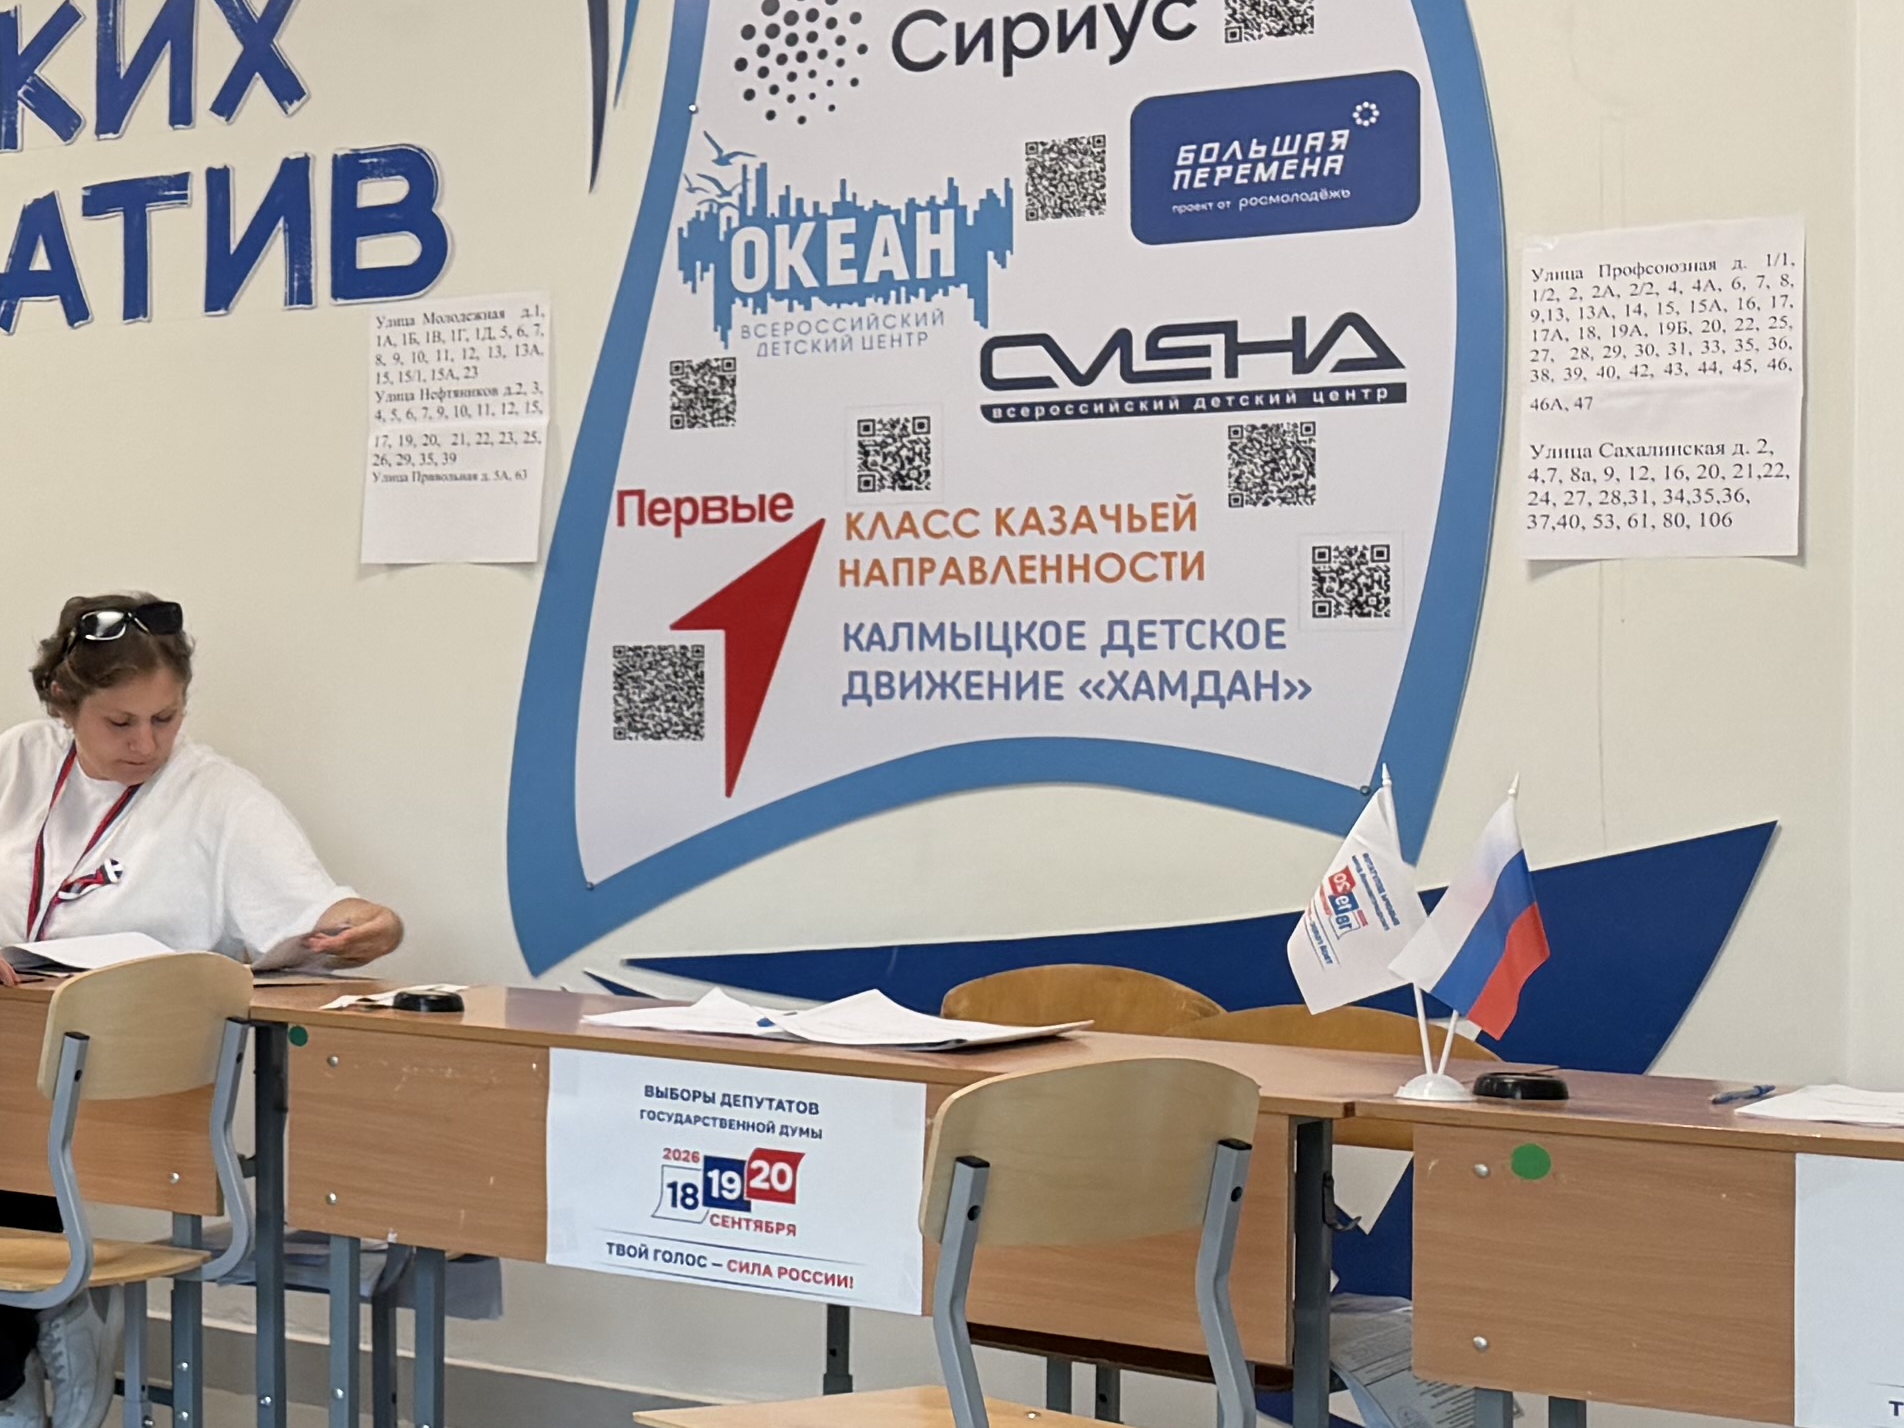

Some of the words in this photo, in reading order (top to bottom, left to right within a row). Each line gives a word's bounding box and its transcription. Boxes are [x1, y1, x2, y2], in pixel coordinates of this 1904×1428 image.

[1177, 129, 1350, 166] БОЛЬШАЯ
[1172, 155, 1345, 191] ПЕРЕМЕНА
[1170, 200, 1215, 215] проект
[1215, 198, 1232, 211] от
[731, 208, 955, 294] ОКЕАН
[1531, 268, 1583, 282] Улица
[1599, 261, 1715, 278] Профсоюзная
[1732, 259, 1745, 269] д.
[1767, 252, 1794, 266] 1/1,
[1533, 287, 1559, 302] 1/2,
[1569, 286, 1582, 300] 2,
[1592, 285, 1620, 298] 2А,
[1630, 281, 1659, 296] 2/2,
[1668, 280, 1682, 294] 4,
[1692, 279, 1721, 291] 4А,
[1731, 277, 1745, 290] 6,
[1757, 275, 1769, 289] 7,
[1780, 274, 1793, 287] 8,
[1530, 307, 1569, 322] 9,13,
[1579, 305, 1615, 319] 13А,
[1626, 303, 1647, 317] 14,
[1658, 301, 1679, 315] 15,
[1691, 299, 1727, 313] 15А,
[1738, 296, 1760, 310] 16,
[1772, 295, 1793, 308] 17,
[740, 311, 944, 340] ВСЕРОССИЙСКИЙ
[1533, 328, 1568, 341] 17А,
[1579, 326, 1600, 339] 18,
[1612, 324, 1647, 337] 19А,
[1659, 321, 1691, 334] 19Б,
[1701, 319, 1725, 333] 20,
[1734, 317, 1759, 331] 22,
[1768, 315, 1792, 329] 25,
[755, 334, 853, 358] ДЕТСКИЙ
[860, 330, 928, 351] ЦЕНТР
[990, 396, 1180, 420] всероссийский
[1191, 390, 1298, 411] детский
[1311, 386, 1389, 405] центр
[1530, 398, 1568, 411] 46А,
[1574, 396, 1592, 409] 47
[1530, 444, 1591, 459] Улица
[1599, 442, 1724, 457] Сахалинская
[1732, 443, 1749, 455] д.
[1757, 438, 1773, 454] 2,
[1528, 467, 1562, 483] 4,7,
[1570, 467, 1596, 482] 8а,
[1604, 466, 1619, 482] 9,
[1630, 465, 1654, 481] 12,
[1665, 465, 1689, 480] 16,
[1697, 464, 1725, 480] 20,
[1733, 462, 1789, 479] 21,22,
[1527, 491, 1556, 506] 24,
[1564, 490, 1591, 506] 27,
[1599, 489, 1655, 506] 28,31,
[1663, 488, 1749, 504] 34,35,36,
[616, 489, 794, 538] Первые
[845, 506, 980, 541] КЛАСС
[994, 500, 1197, 537] КАЗАЧЬЕЙ
[1527, 514, 1585, 530] 37,40,
[1593, 513, 1620, 529] 53,
[1627, 513, 1655, 528] 61,
[1663, 512, 1690, 529] 80,
[1701, 511, 1732, 527] 106
[838, 549, 1205, 588] НАПРАВЛЕННОСТИ
[842, 619, 1087, 655] КАЛМЫЦКОЕ
[1099, 616, 1287, 655] ДЕТСКОЕ
[840, 668, 1065, 706] ДВИЖЕНИЕ
[1077, 667, 1313, 706] «ХАМДАН»
[643, 1084, 716, 1105] ВЫБОРЫ
[719, 1092, 820, 1115] ДЕПУТАТОВ
[639, 1108, 776, 1134] ГОСУДАРСТВЕННОЙ
[778, 1123, 823, 1140] ДУМЫ
[662, 1147, 701, 1164] 2026
[666, 1181, 700, 1211] 18
[707, 1169, 742, 1201] 19
[749, 1160, 794, 1192] 20
[709, 1213, 797, 1237] СЕНТЯБРЯ
[605, 1241, 649, 1260] ТВОЙ
[652, 1248, 707, 1268] ГОЛОС
[726, 1258, 773, 1278] СИЛА
[776, 1265, 854, 1289] РОССИИ!
